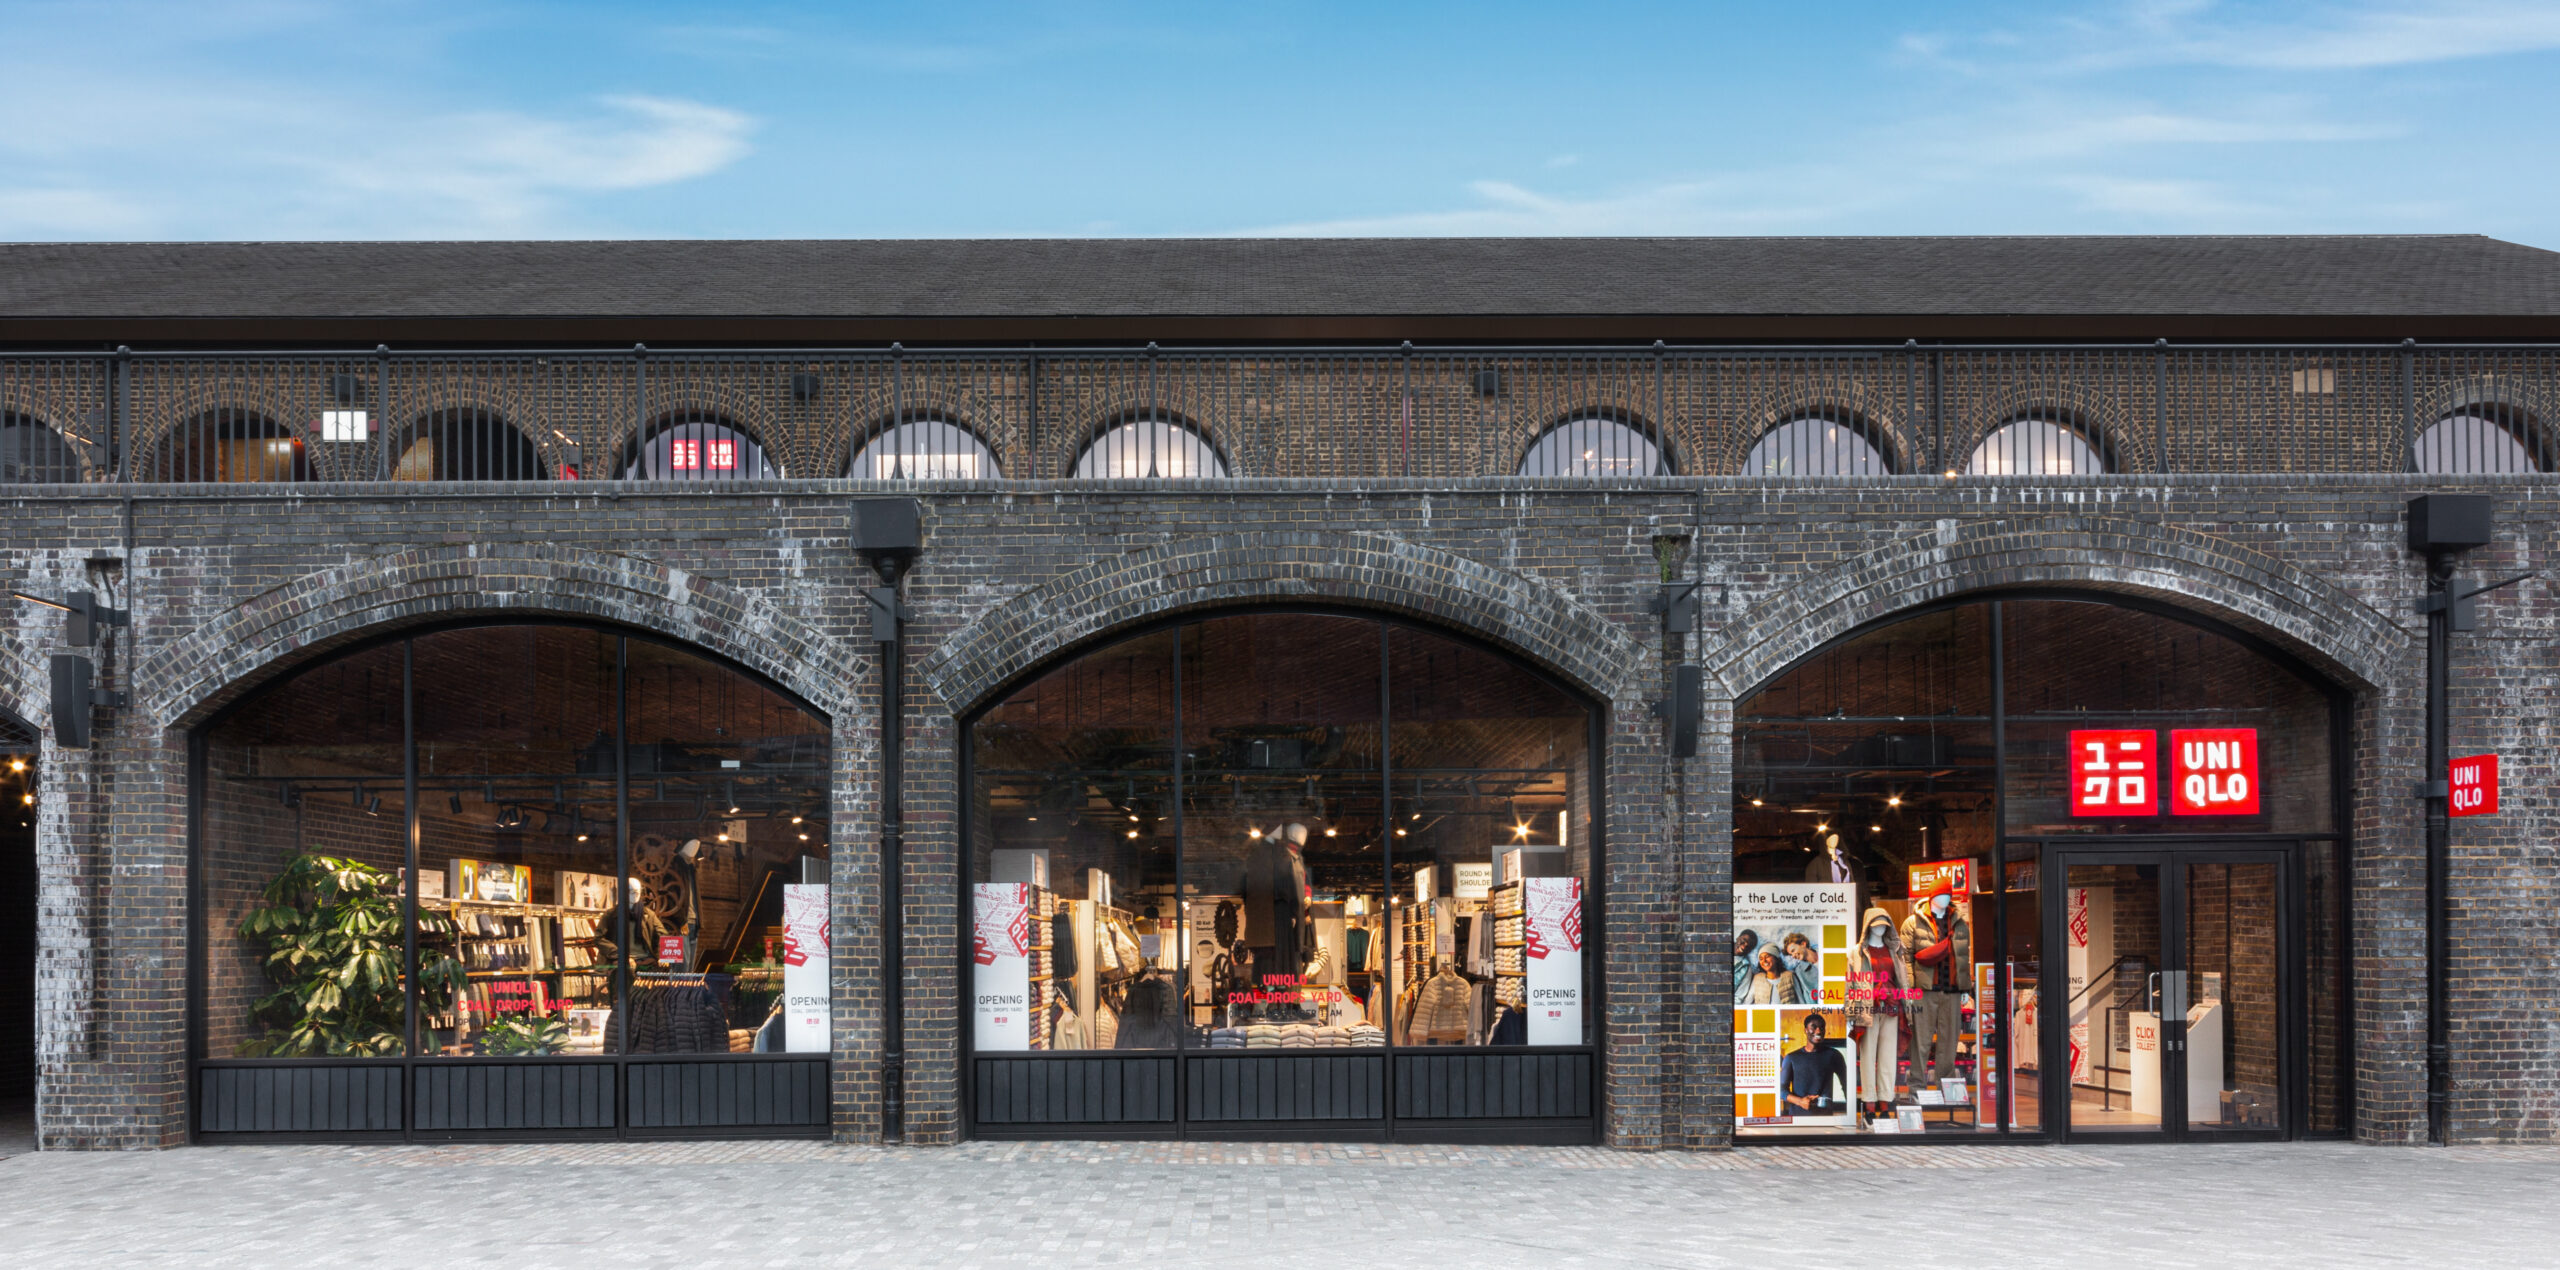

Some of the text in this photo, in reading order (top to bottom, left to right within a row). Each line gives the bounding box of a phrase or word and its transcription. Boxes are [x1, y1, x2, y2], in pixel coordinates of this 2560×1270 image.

[2084, 742, 2144, 770] ユニ
[2184, 741, 2240, 770] UNI
[2454, 765, 2480, 786] UNI
[2083, 776, 2145, 805] クロ
[2185, 773, 2248, 807] QLO
[2454, 787, 2482, 811] QLO
[1733, 892, 1847, 904] or the Love of Cold.
[1012, 922, 1029, 951] QLO
[1565, 917, 1582, 945] QLO
[1262, 974, 1308, 987] UNIQLO
[1845, 970, 1889, 984] UNIQLO
[494, 981, 538, 995] UNIQLO
[1533, 989, 1576, 999] OPENING
[1810, 987, 1924, 1001] COAL DROPS YARD
[790, 996, 830, 1006] OPENIN
[978, 995, 1023, 1005] OPENING
[1228, 991, 1342, 1004] COAL DROPS YARD
[458, 999, 574, 1011] COAL DROPS YARD
[1810, 1006, 1833, 1015] OPEN
[2135, 1025, 2156, 1040] CLICK
